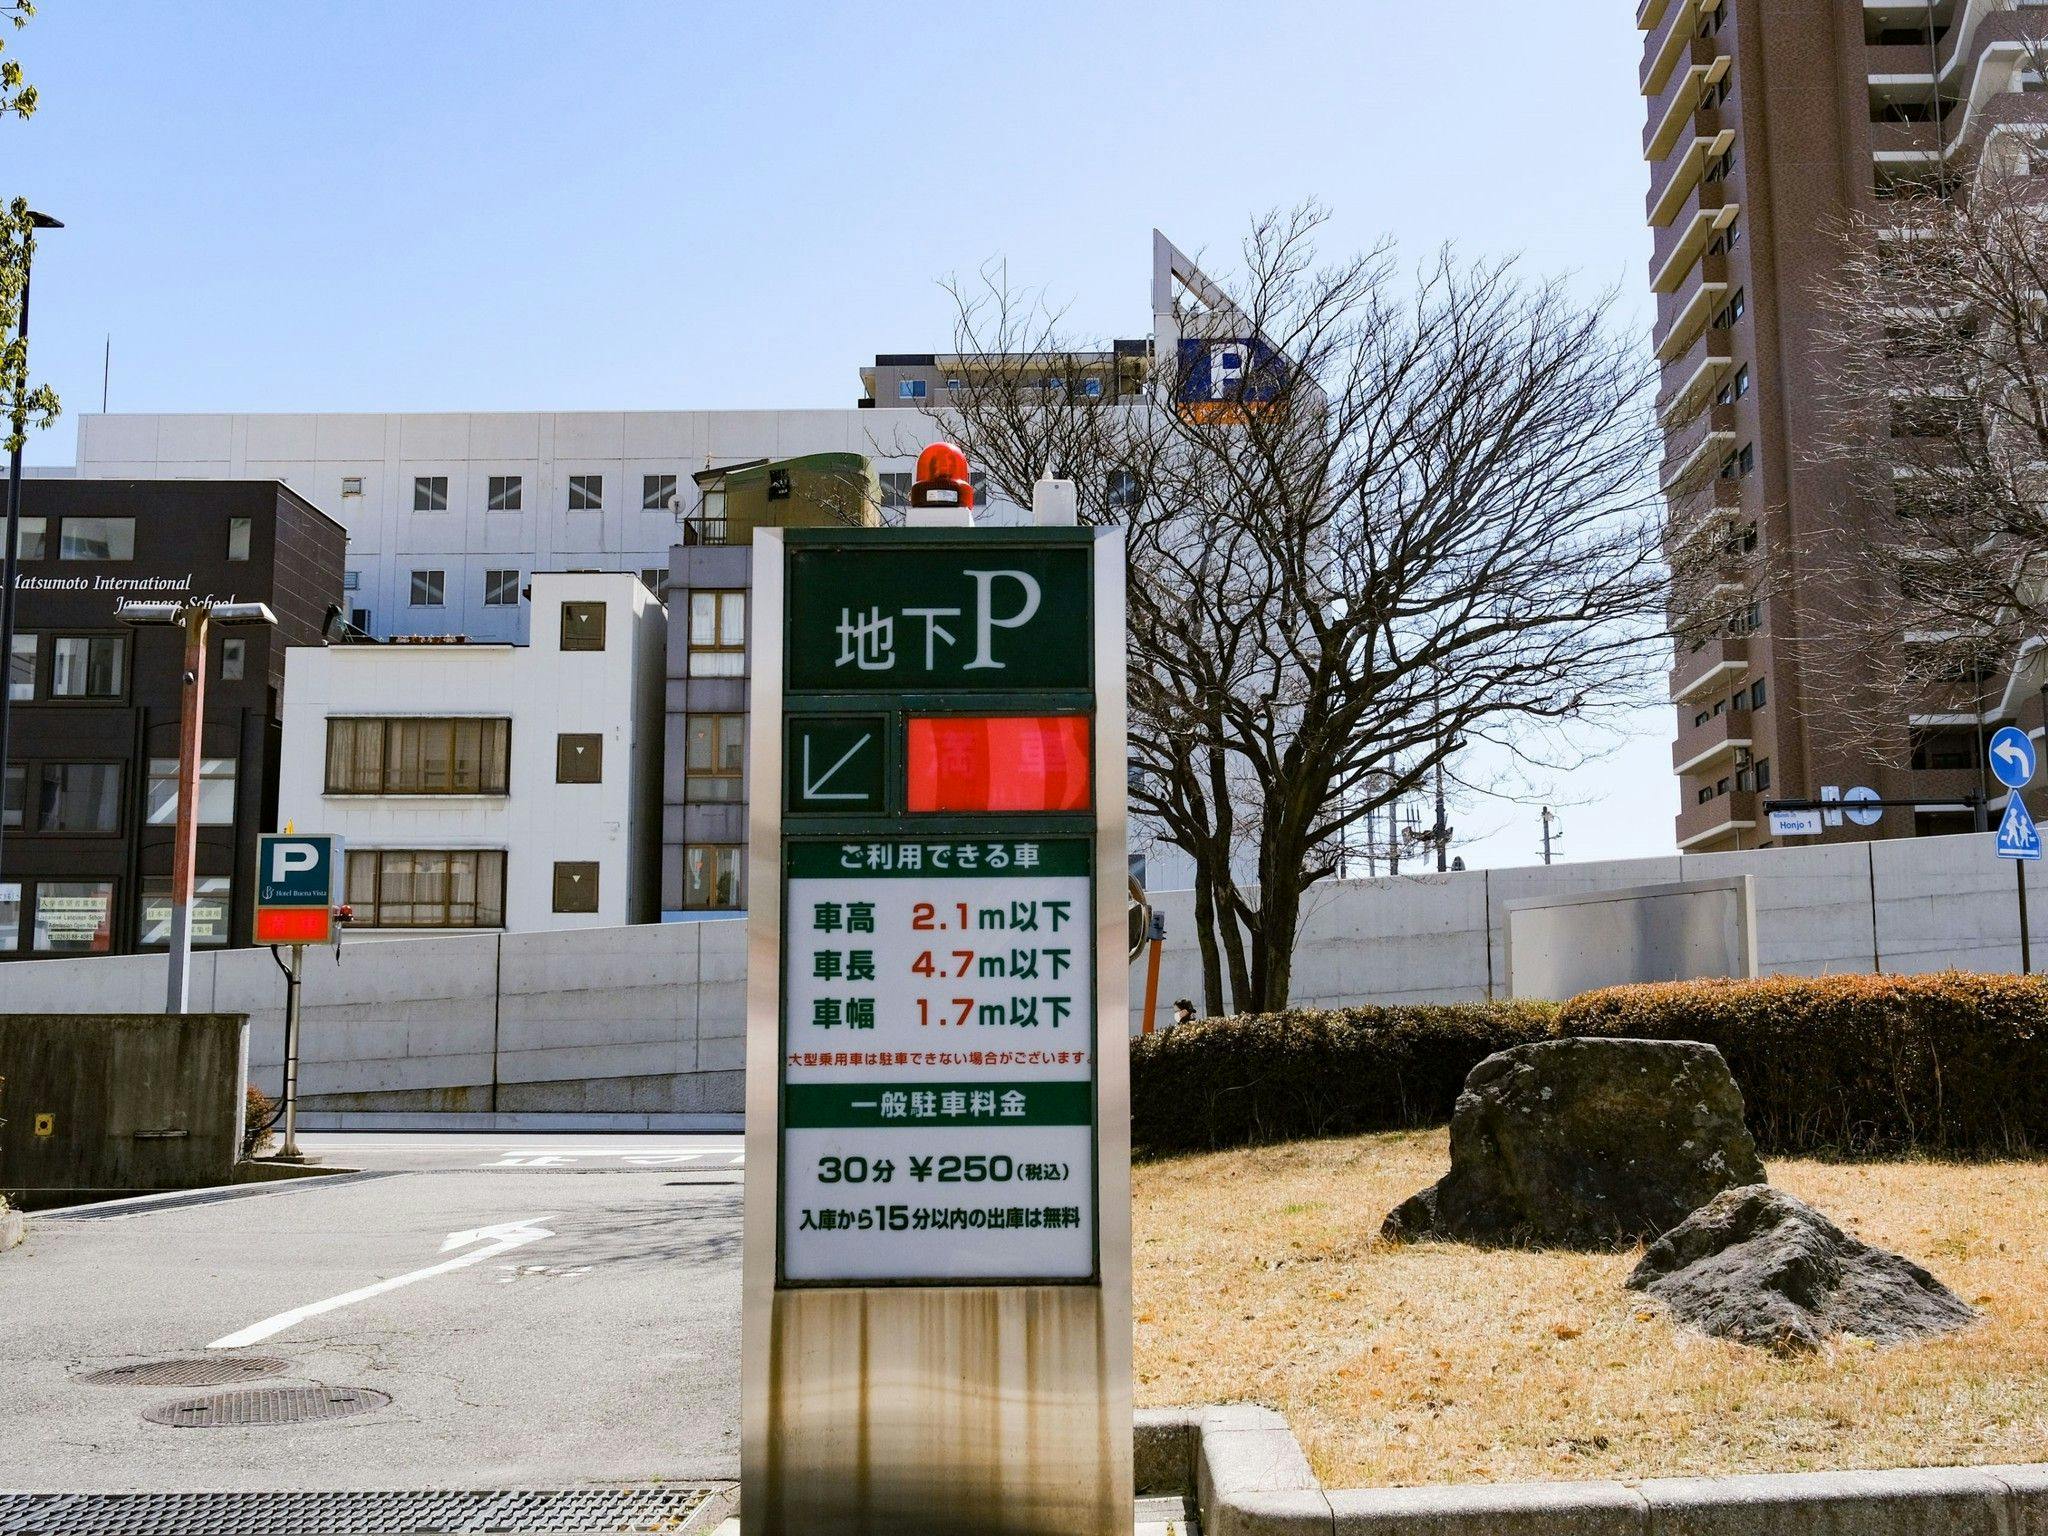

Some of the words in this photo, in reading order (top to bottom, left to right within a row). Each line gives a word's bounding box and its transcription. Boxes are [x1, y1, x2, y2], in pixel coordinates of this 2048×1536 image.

[93, 574, 192, 590] International
[1780, 821, 1804, 830] Honjo
[272, 843, 319, 882] P
[841, 843, 1039, 869] ご利用できる車
[813, 902, 876, 933] 車高
[912, 901, 1071, 933] 2.1m以下
[813, 950, 876, 981] 車長
[912, 949, 1071, 980] 4.7m以下
[813, 997, 876, 1029] 車幅
[916, 996, 1071, 1028] 1.7m以下
[851, 1090, 1027, 1118] 一般駐車料金
[818, 1156, 896, 1184] 30分
[799, 1205, 1081, 1231] 入庫から15分以内の出庫は無料
